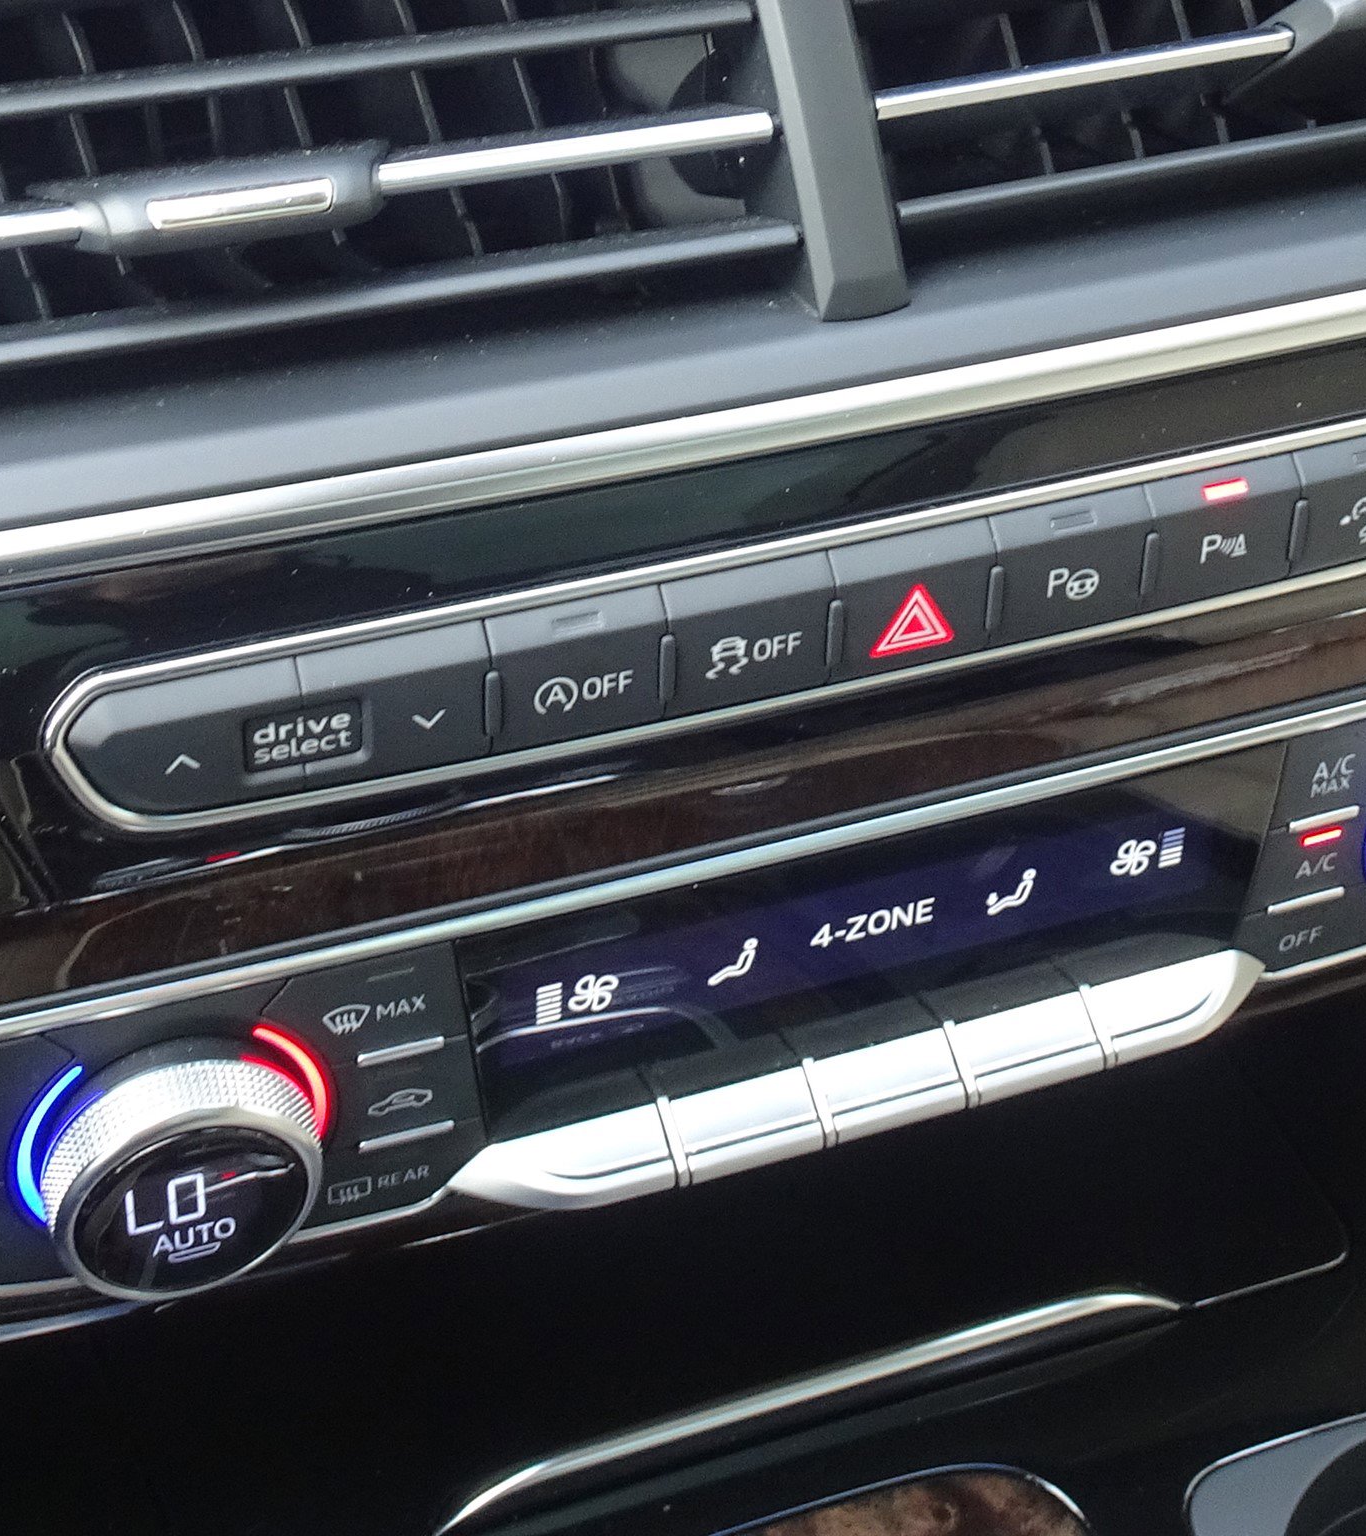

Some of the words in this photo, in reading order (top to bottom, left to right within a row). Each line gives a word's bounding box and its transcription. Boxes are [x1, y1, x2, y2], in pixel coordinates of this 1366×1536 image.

[750, 630, 804, 664] OFF
[581, 669, 635, 703] OFF
[250, 708, 354, 747] drive
[251, 726, 354, 765] select
[1311, 752, 1356, 786] A/C
[1309, 774, 1353, 799] MAX
[1294, 851, 1339, 880] A/C
[809, 896, 938, 951] 4-ZONE
[1277, 924, 1323, 954] OFF
[375, 993, 428, 1024] MAX
[377, 1163, 432, 1193] REAR
[152, 1216, 238, 1260] AUTO
